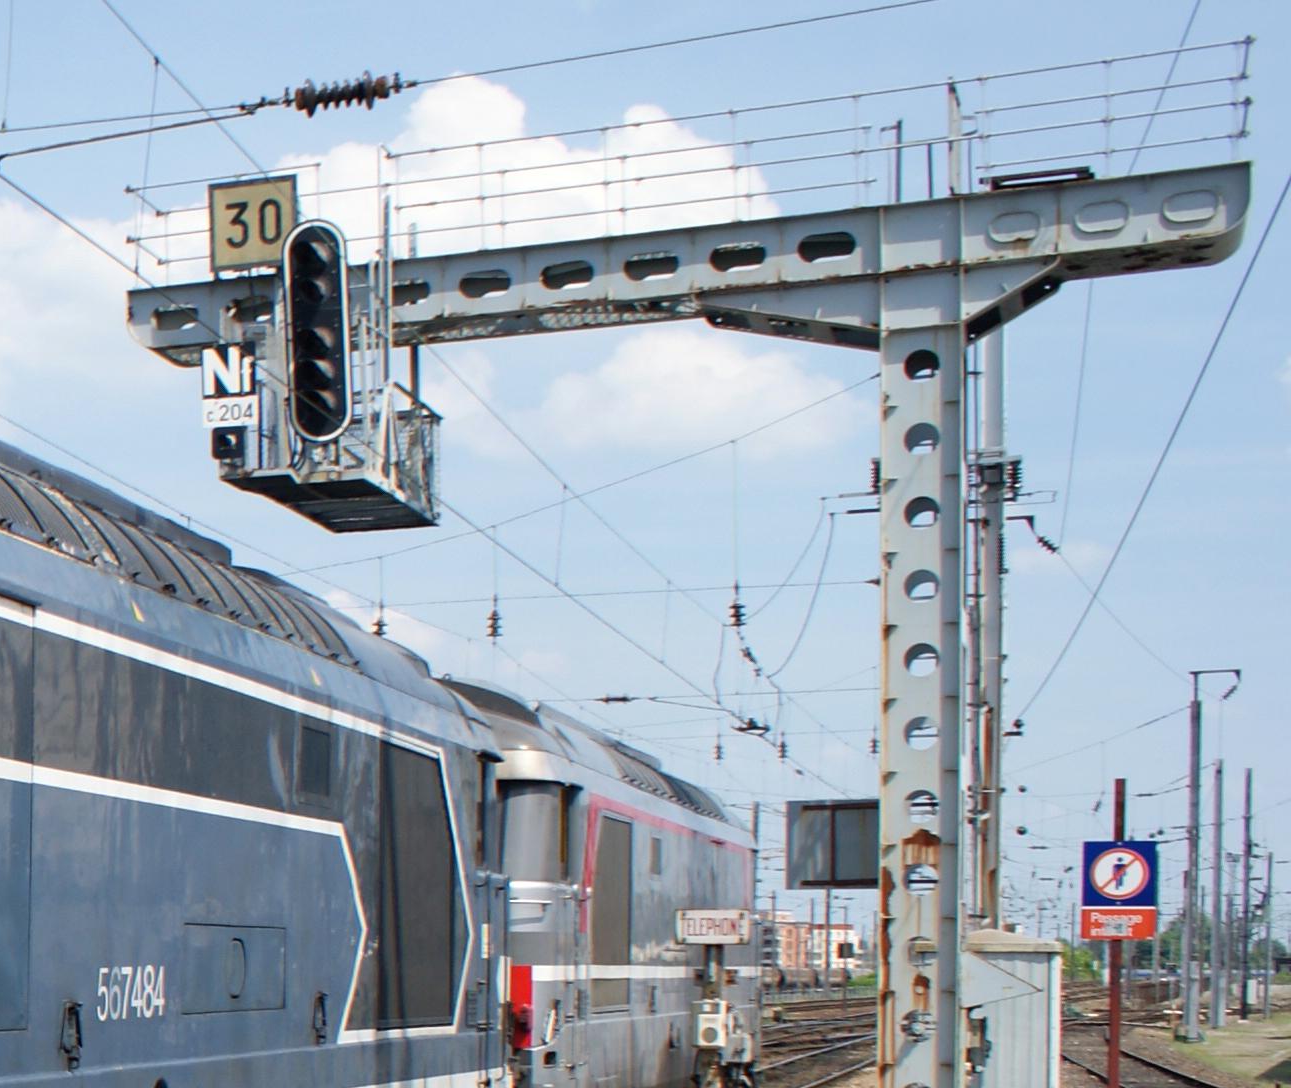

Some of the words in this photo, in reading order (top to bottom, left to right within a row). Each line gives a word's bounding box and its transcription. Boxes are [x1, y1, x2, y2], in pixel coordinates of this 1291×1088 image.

[224, 197, 282, 248] 30
[203, 348, 254, 396] Nf
[1090, 911, 1143, 927] Passage
[97, 964, 166, 1022] 567484
